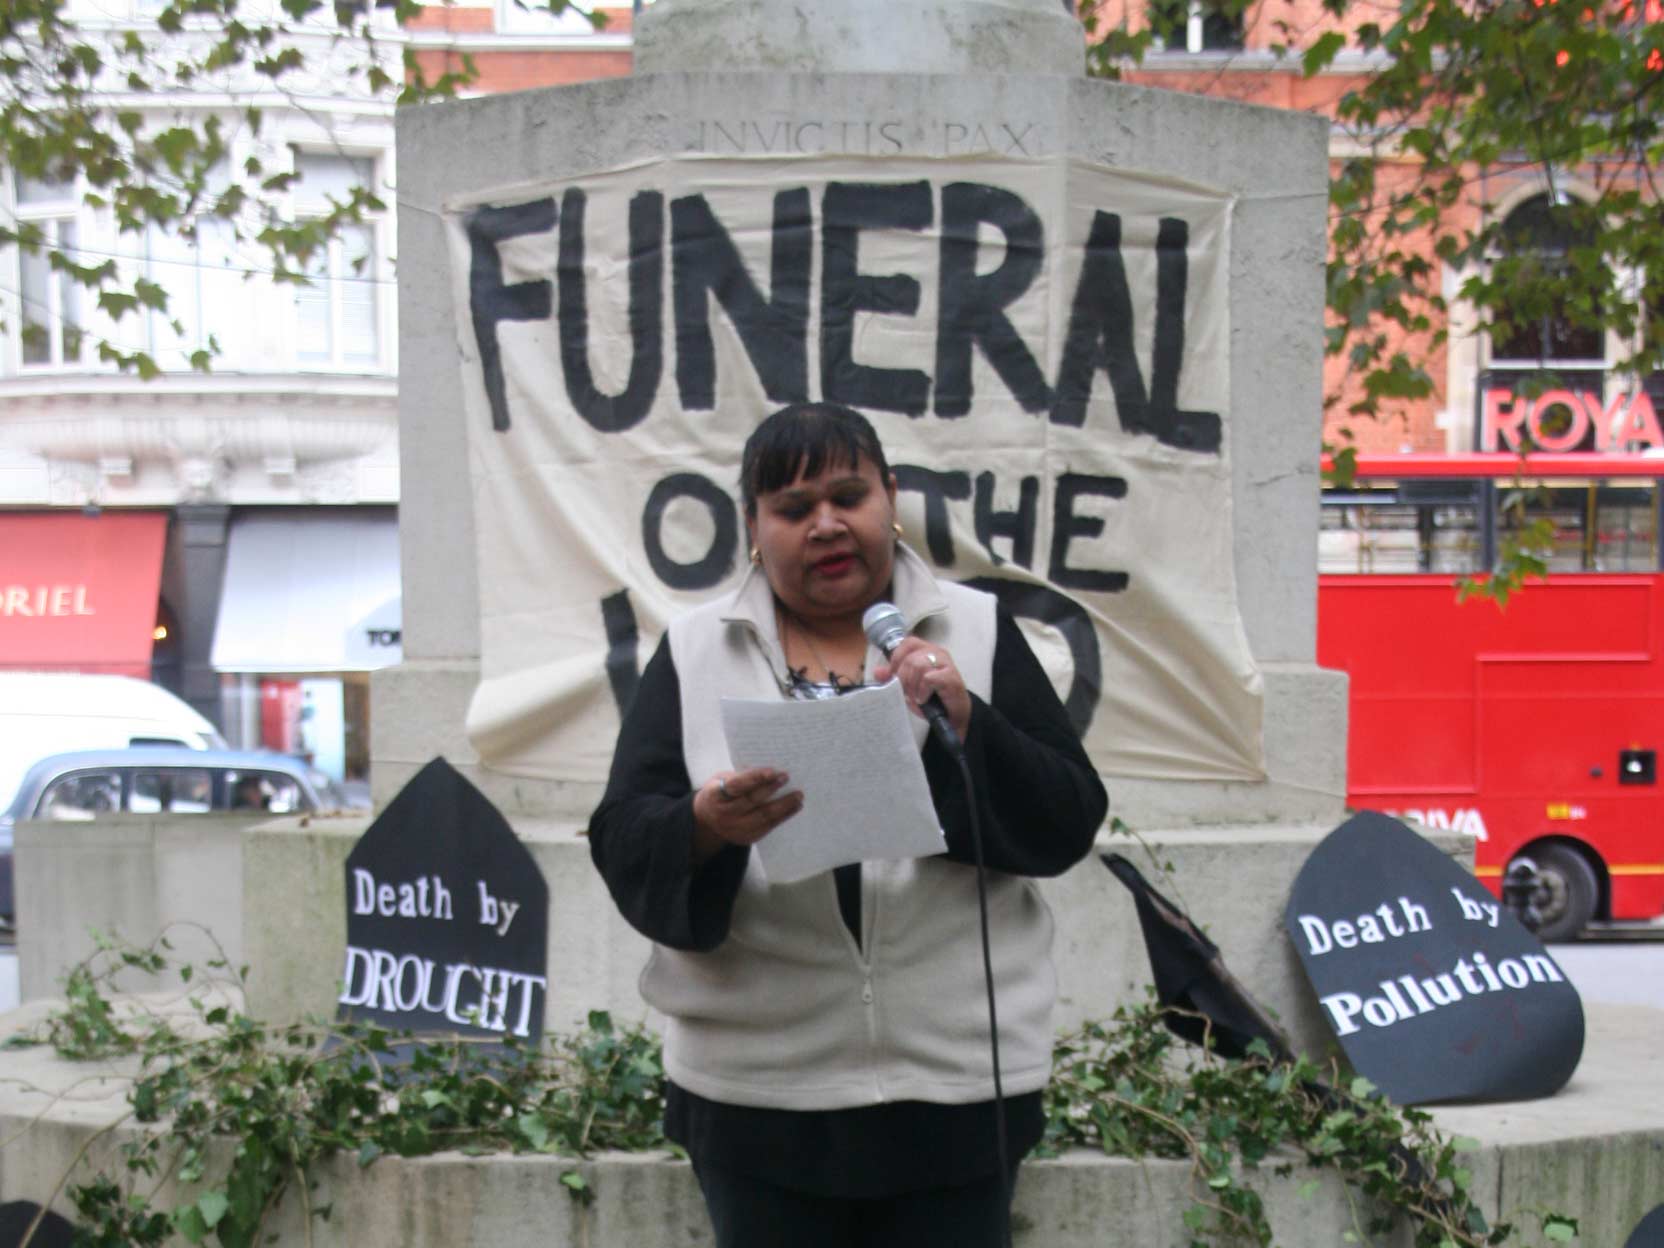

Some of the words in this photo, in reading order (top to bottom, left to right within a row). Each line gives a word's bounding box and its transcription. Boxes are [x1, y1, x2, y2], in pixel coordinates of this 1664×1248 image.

[944, 121, 1036, 157] PAX
[470, 180, 1222, 454] FUNERAL
[1480, 386, 1664, 453] ROYA
[641, 472, 738, 590] O
[889, 464, 1129, 593] THE
[0, 583, 96, 617] RIEL
[353, 867, 453, 920] Death
[477, 880, 520, 936] by
[1299, 896, 1432, 956] Death
[1451, 887, 1499, 928] by
[338, 946, 546, 1036] DROUGHT
[1319, 951, 1564, 1037] Pollution
